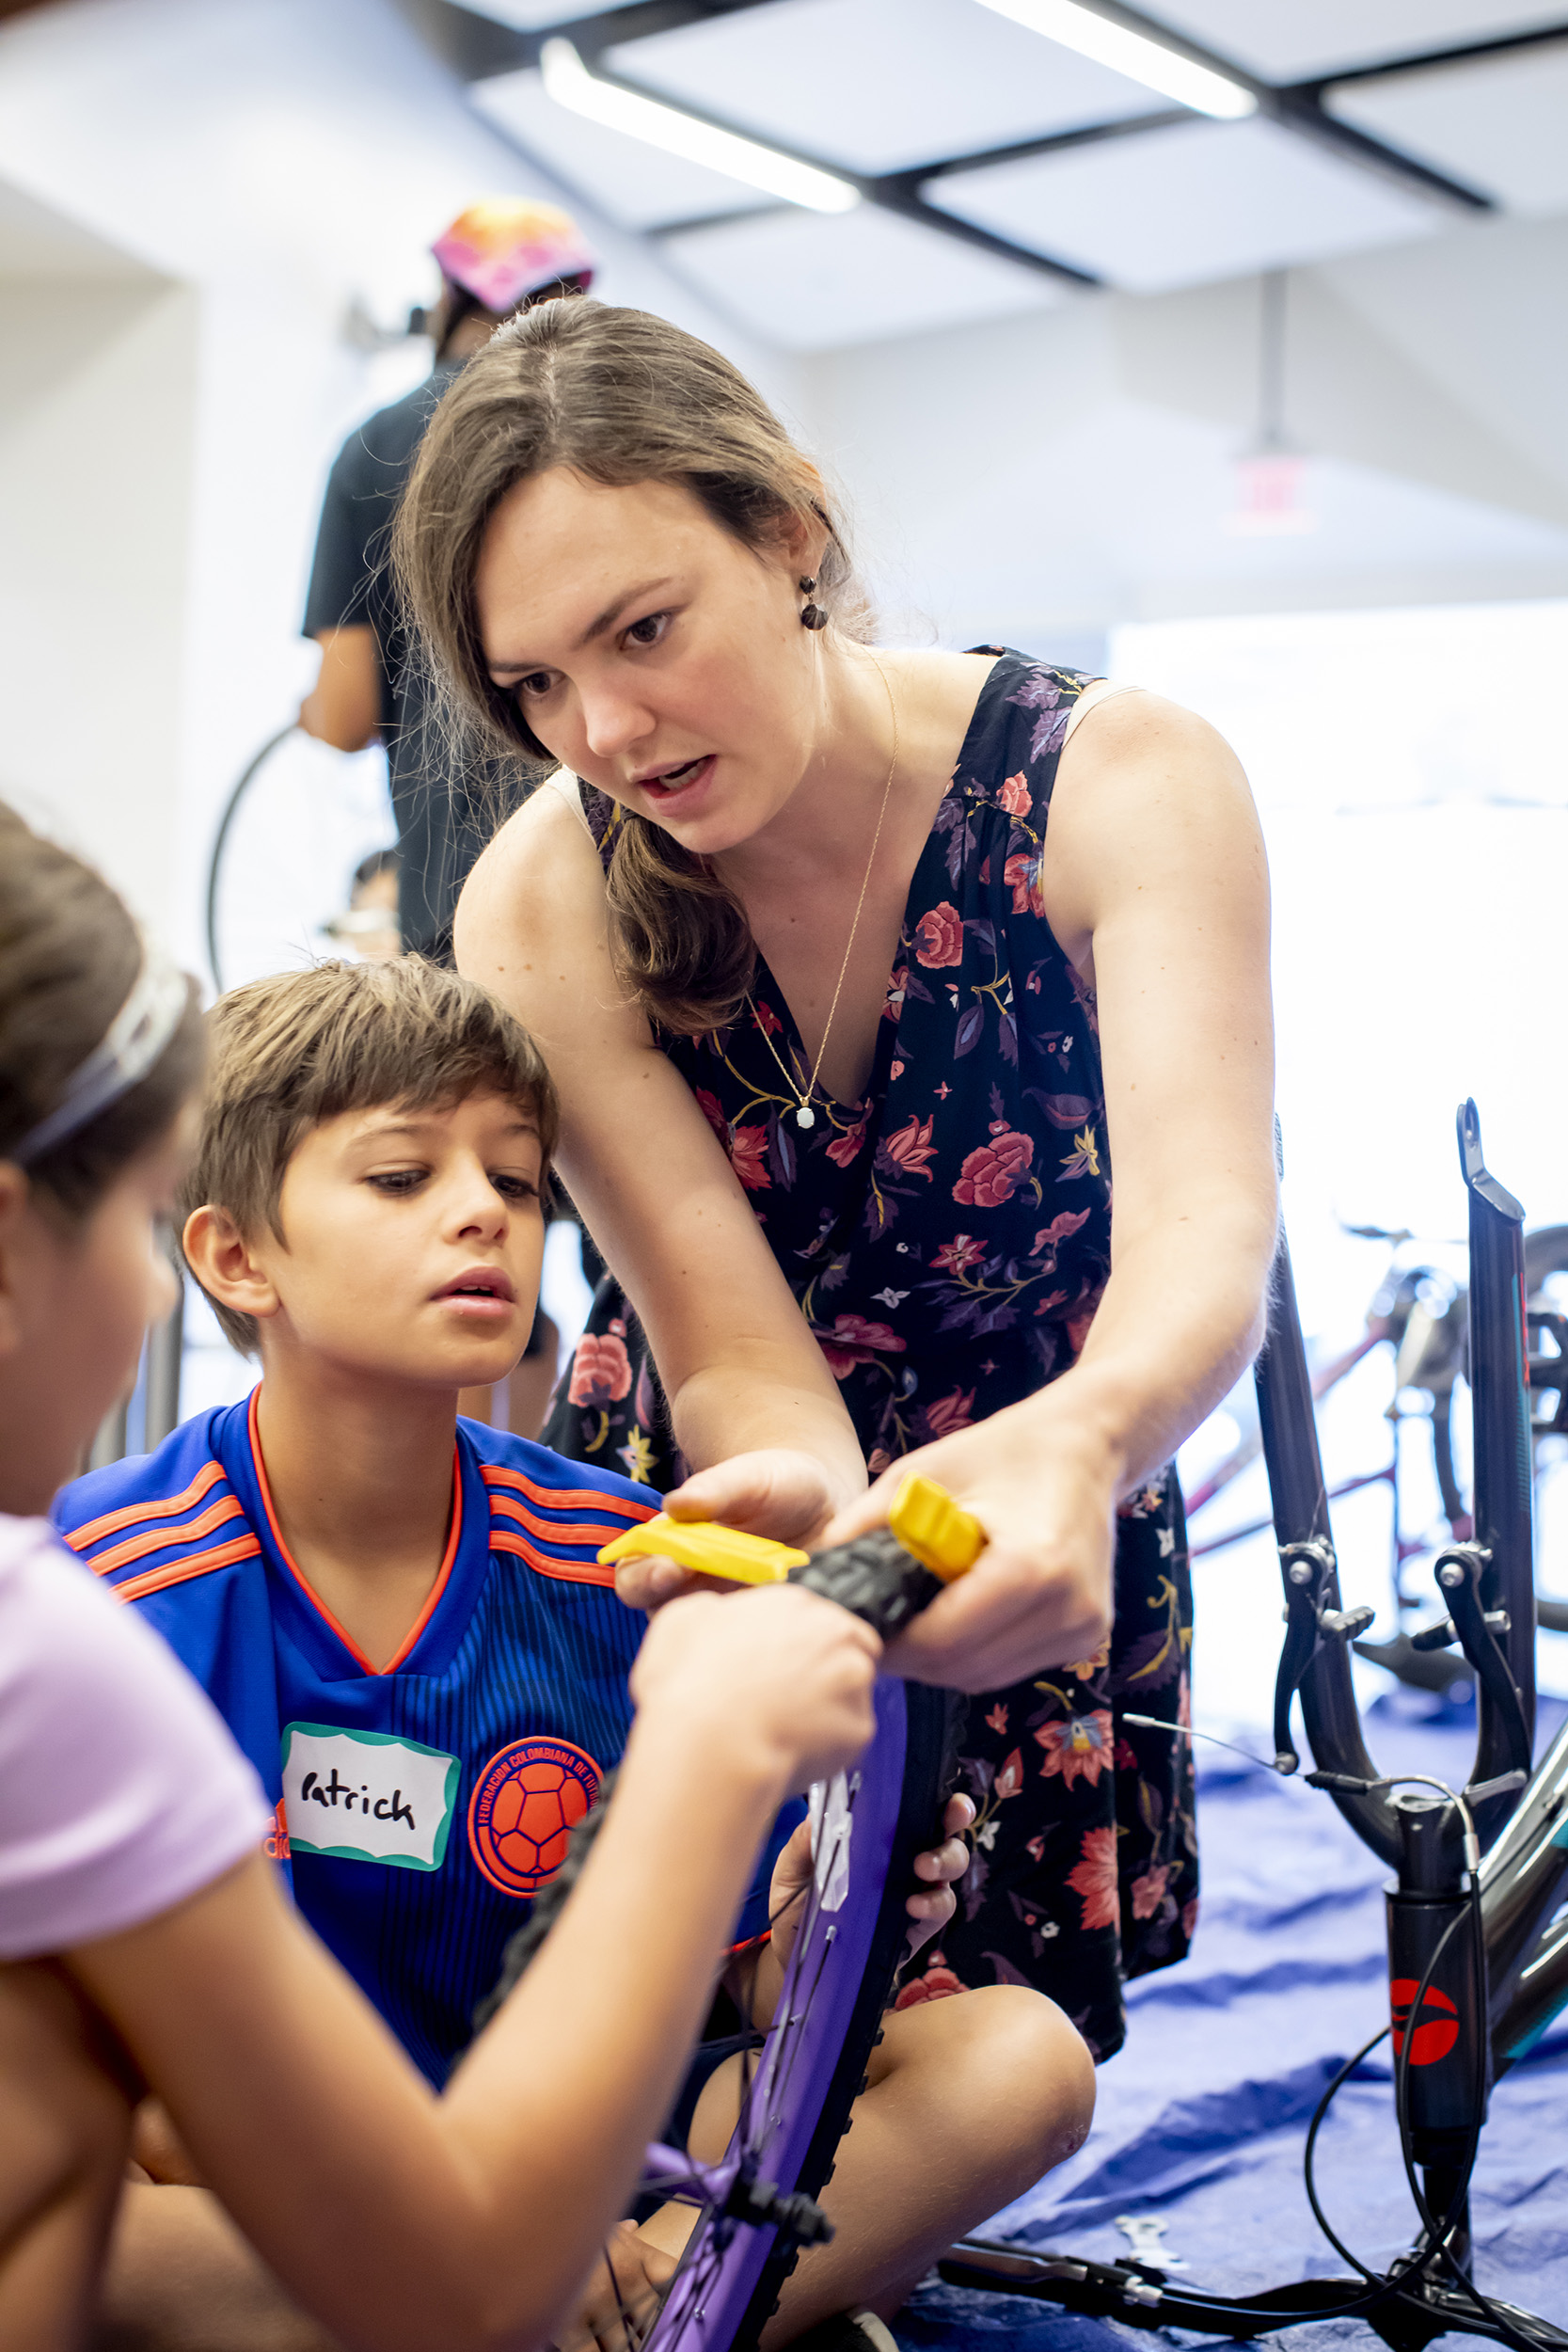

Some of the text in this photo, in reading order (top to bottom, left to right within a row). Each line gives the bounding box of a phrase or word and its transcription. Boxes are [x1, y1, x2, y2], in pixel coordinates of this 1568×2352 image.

[302, 1769, 415, 1830] Patrick
[478, 1747, 599, 1823] FEDERACION COLOMBIANA DE FUTBO
